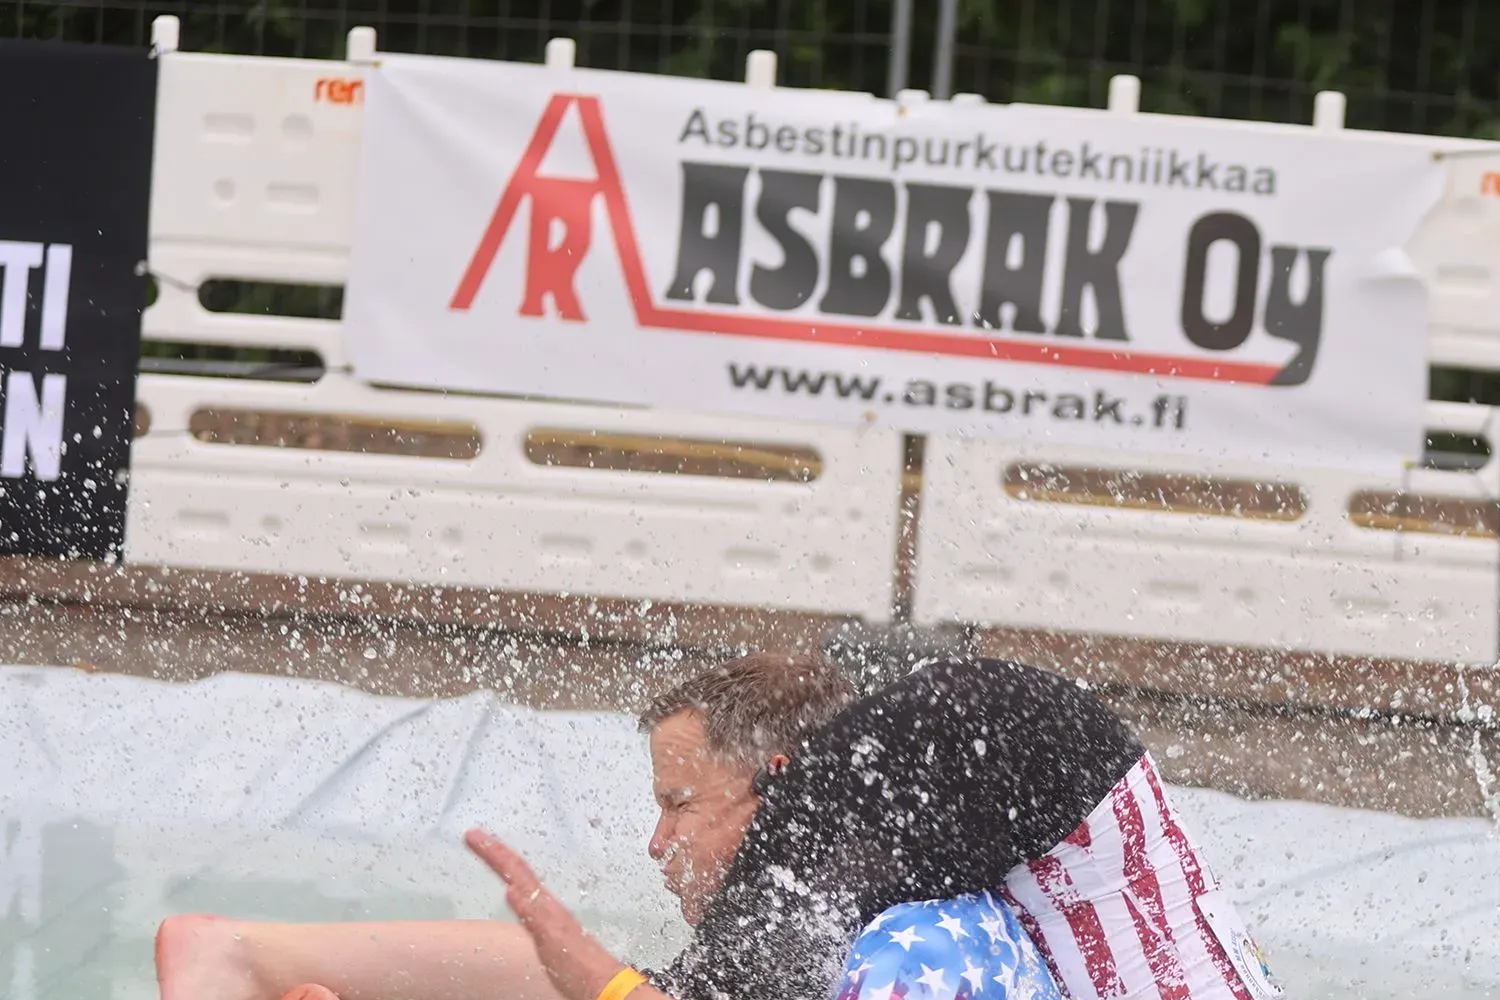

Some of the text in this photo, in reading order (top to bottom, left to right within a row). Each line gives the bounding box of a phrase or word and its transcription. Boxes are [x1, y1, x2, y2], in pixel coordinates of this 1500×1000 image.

[678, 108, 1277, 197] Asbestinpurkutekniikkaa
[665, 160, 1334, 387] ASBRAK Oy
[728, 361, 1188, 432] www.asbrak.fi
